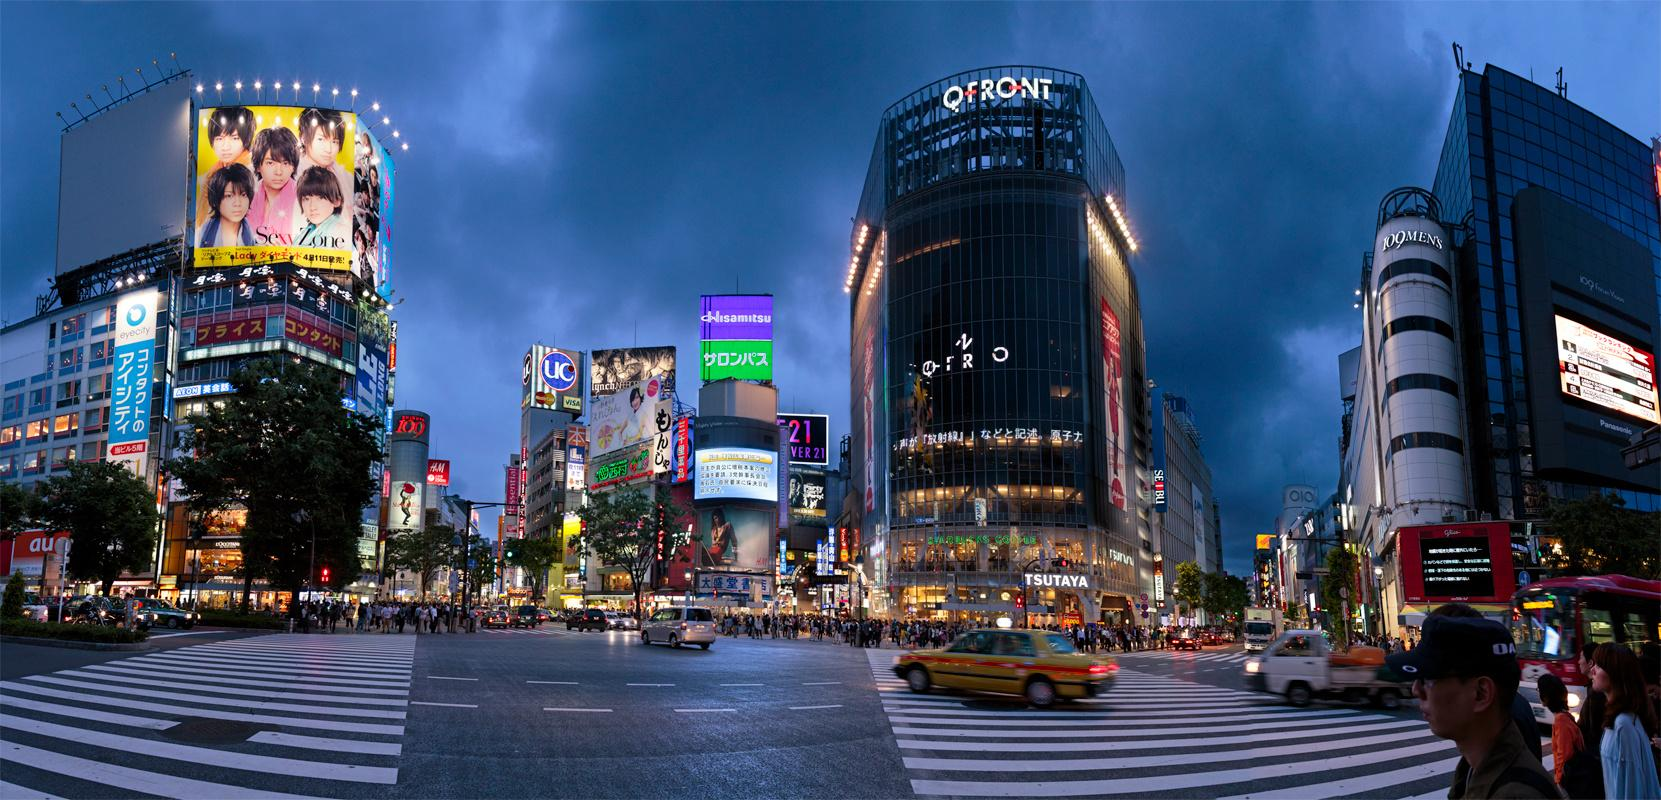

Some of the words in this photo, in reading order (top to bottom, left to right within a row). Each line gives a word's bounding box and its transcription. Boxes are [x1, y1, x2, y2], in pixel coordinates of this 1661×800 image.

[943, 77, 1052, 112] QFRONT
[255, 226, 293, 247] Sexy
[298, 228, 345, 249] Zone
[235, 252, 256, 261] Lady
[701, 310, 771, 323] Hisamitsu
[120, 327, 150, 340] eyecity
[197, 320, 263, 341] プライス
[286, 319, 341, 350] コンタクト
[703, 352, 768, 366] サロンパス
[544, 359, 574, 382] UC
[114, 352, 135, 435] アイシティ
[132, 348, 150, 433] コンタクトの
[176, 386, 199, 396] AEON
[202, 383, 230, 394] 英会話
[395, 419, 426, 437] 109
[1600, 419, 1632, 435] Panasonic
[655, 408, 671, 470] もんじゃ
[114, 443, 143, 455] 当ビル5階
[814, 447, 825, 459] 21
[430, 463, 445, 473] H&M
[508, 467, 518, 513] Essential
[30, 537, 50, 552] au
[1025, 574, 1088, 588] TSUTAYA
